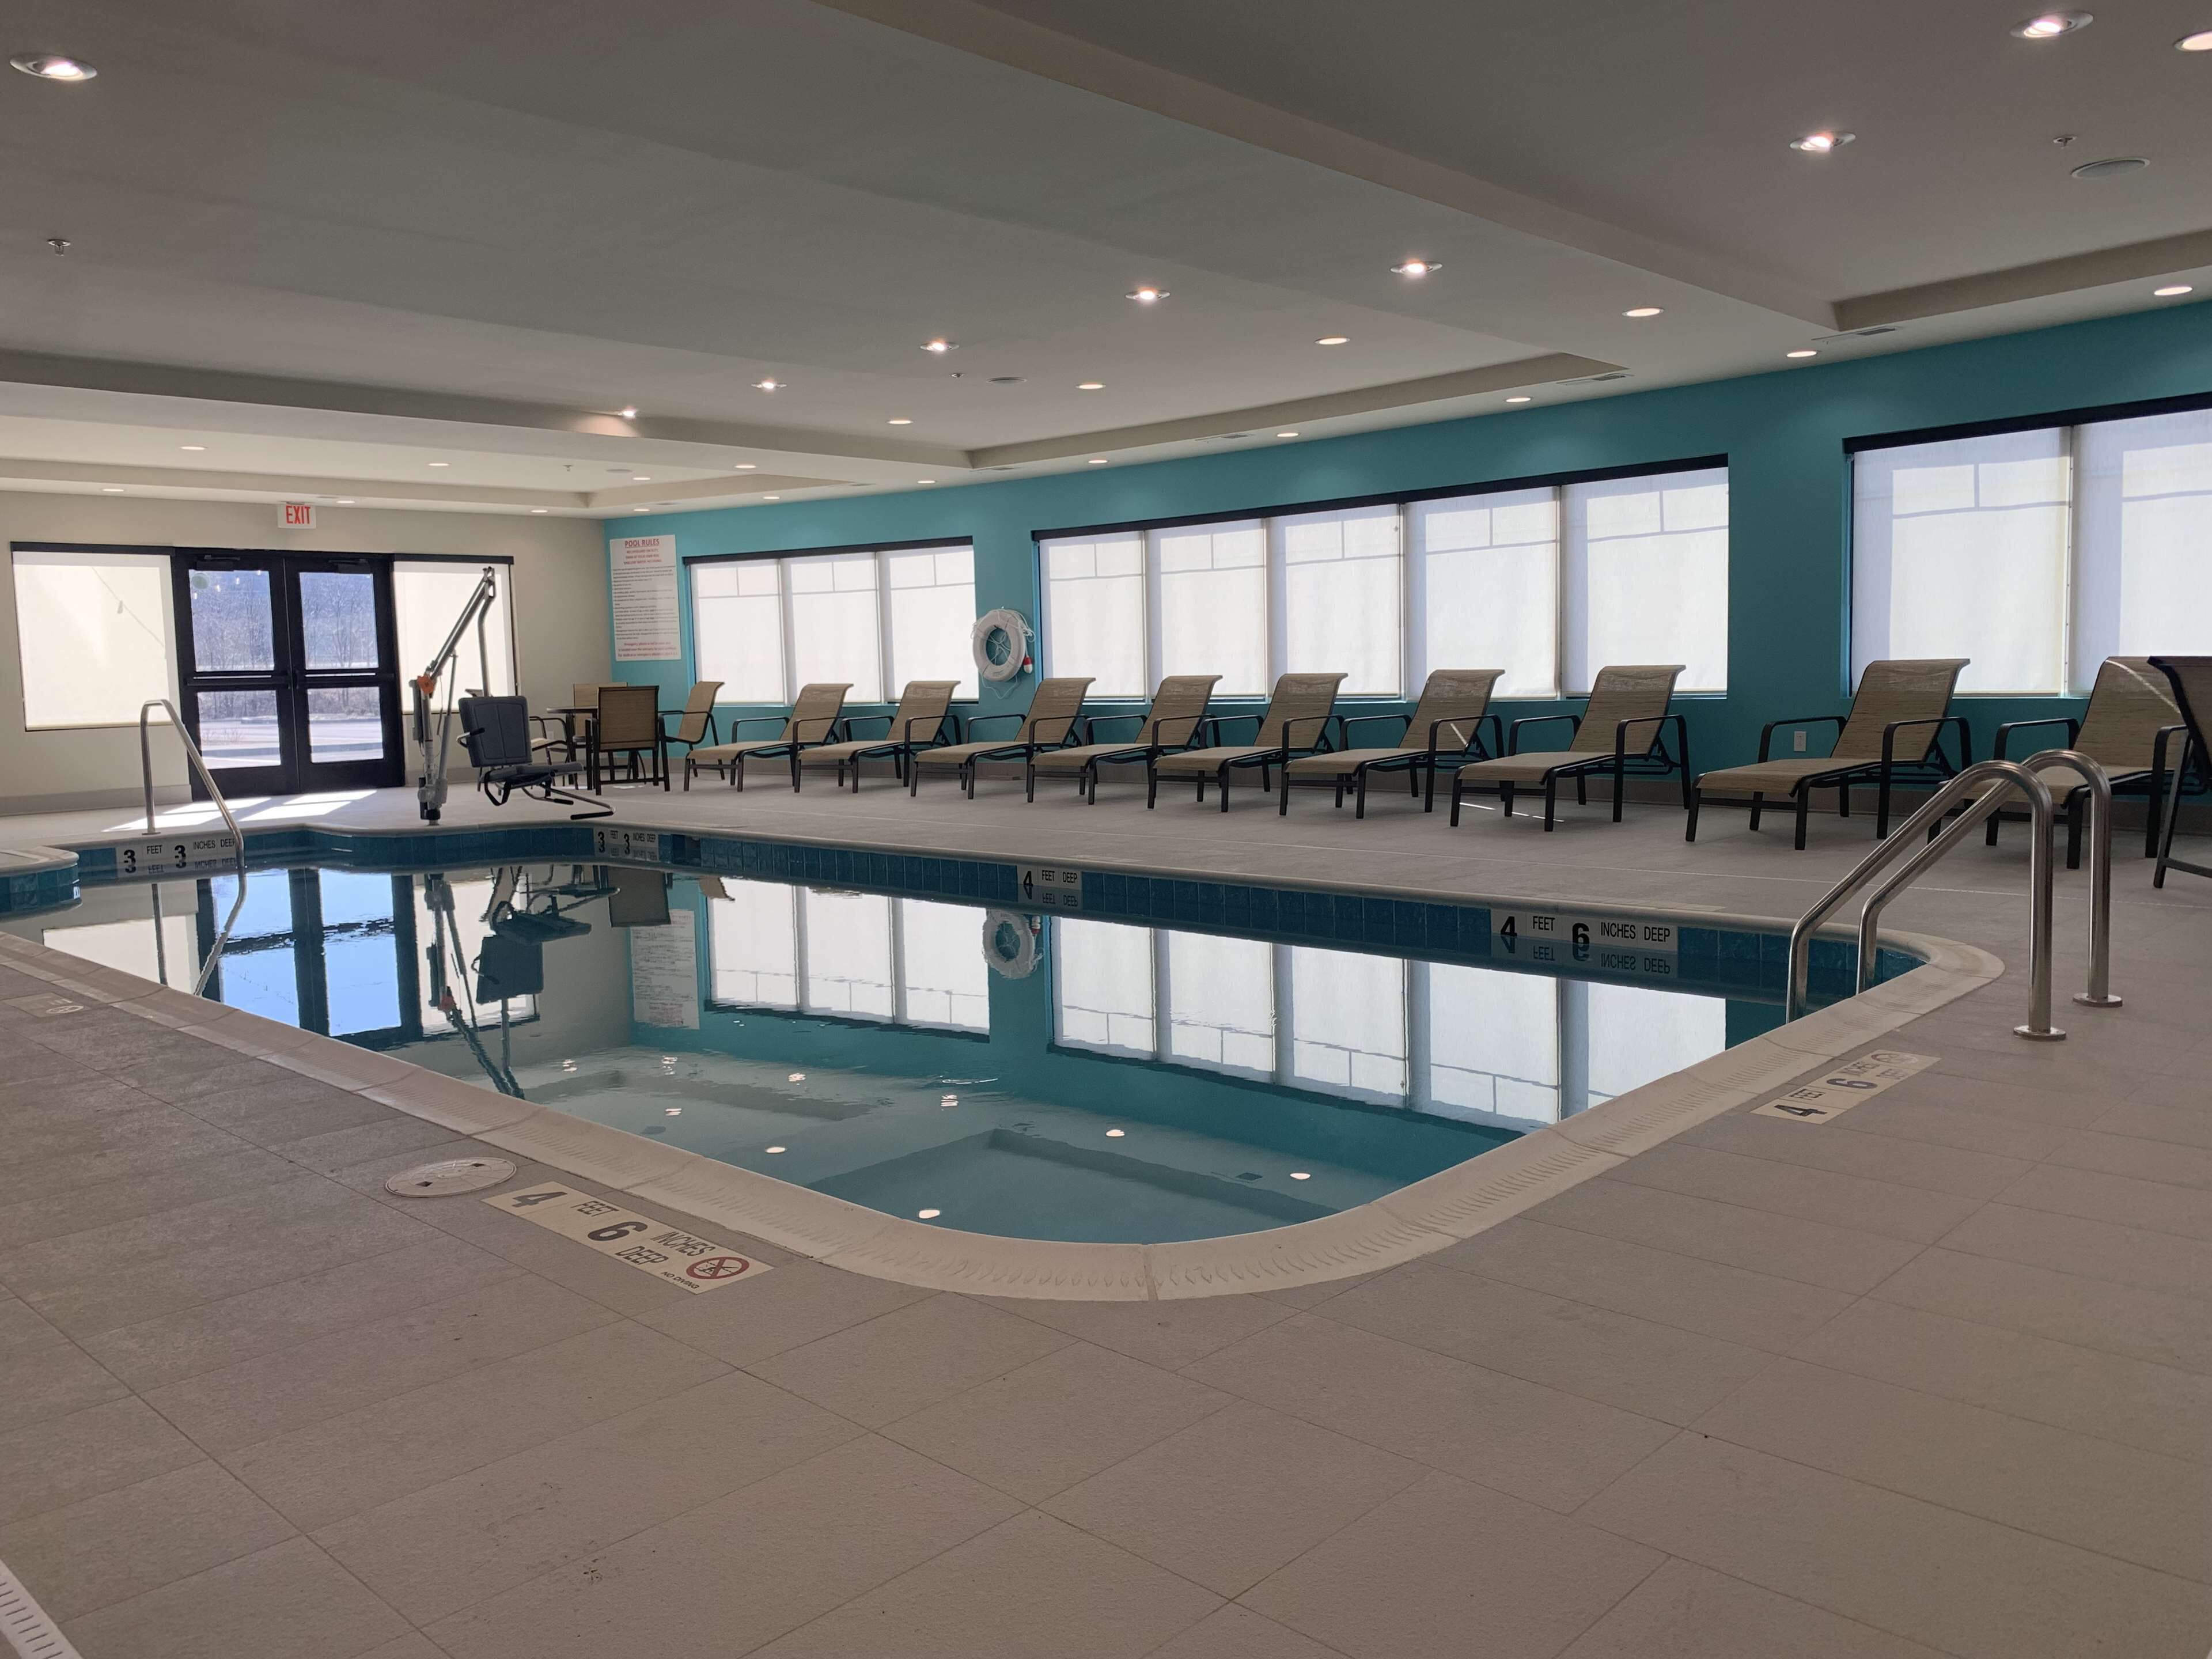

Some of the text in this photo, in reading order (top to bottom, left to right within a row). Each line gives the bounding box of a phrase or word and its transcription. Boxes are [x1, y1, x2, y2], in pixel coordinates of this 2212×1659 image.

[286, 506, 310, 524] EXIT
[124, 850, 136, 866] 3
[147, 844, 162, 855] FEET
[175, 845, 186, 862] 3
[194, 840, 215, 850] INCHES
[1023, 870, 1077, 887] 4 FEET DEEP
[1501, 916, 1670, 945] 4 FEET 6 INCHES DEEP
[1827, 1078, 1877, 1089] 6
[1774, 1105, 1827, 1116] 4
[512, 1191, 620, 1217] 4 FEET
[588, 1221, 716, 1256] 6 INCHES
[614, 1245, 669, 1265] DEEP
[673, 1277, 700, 1289] DIVING
